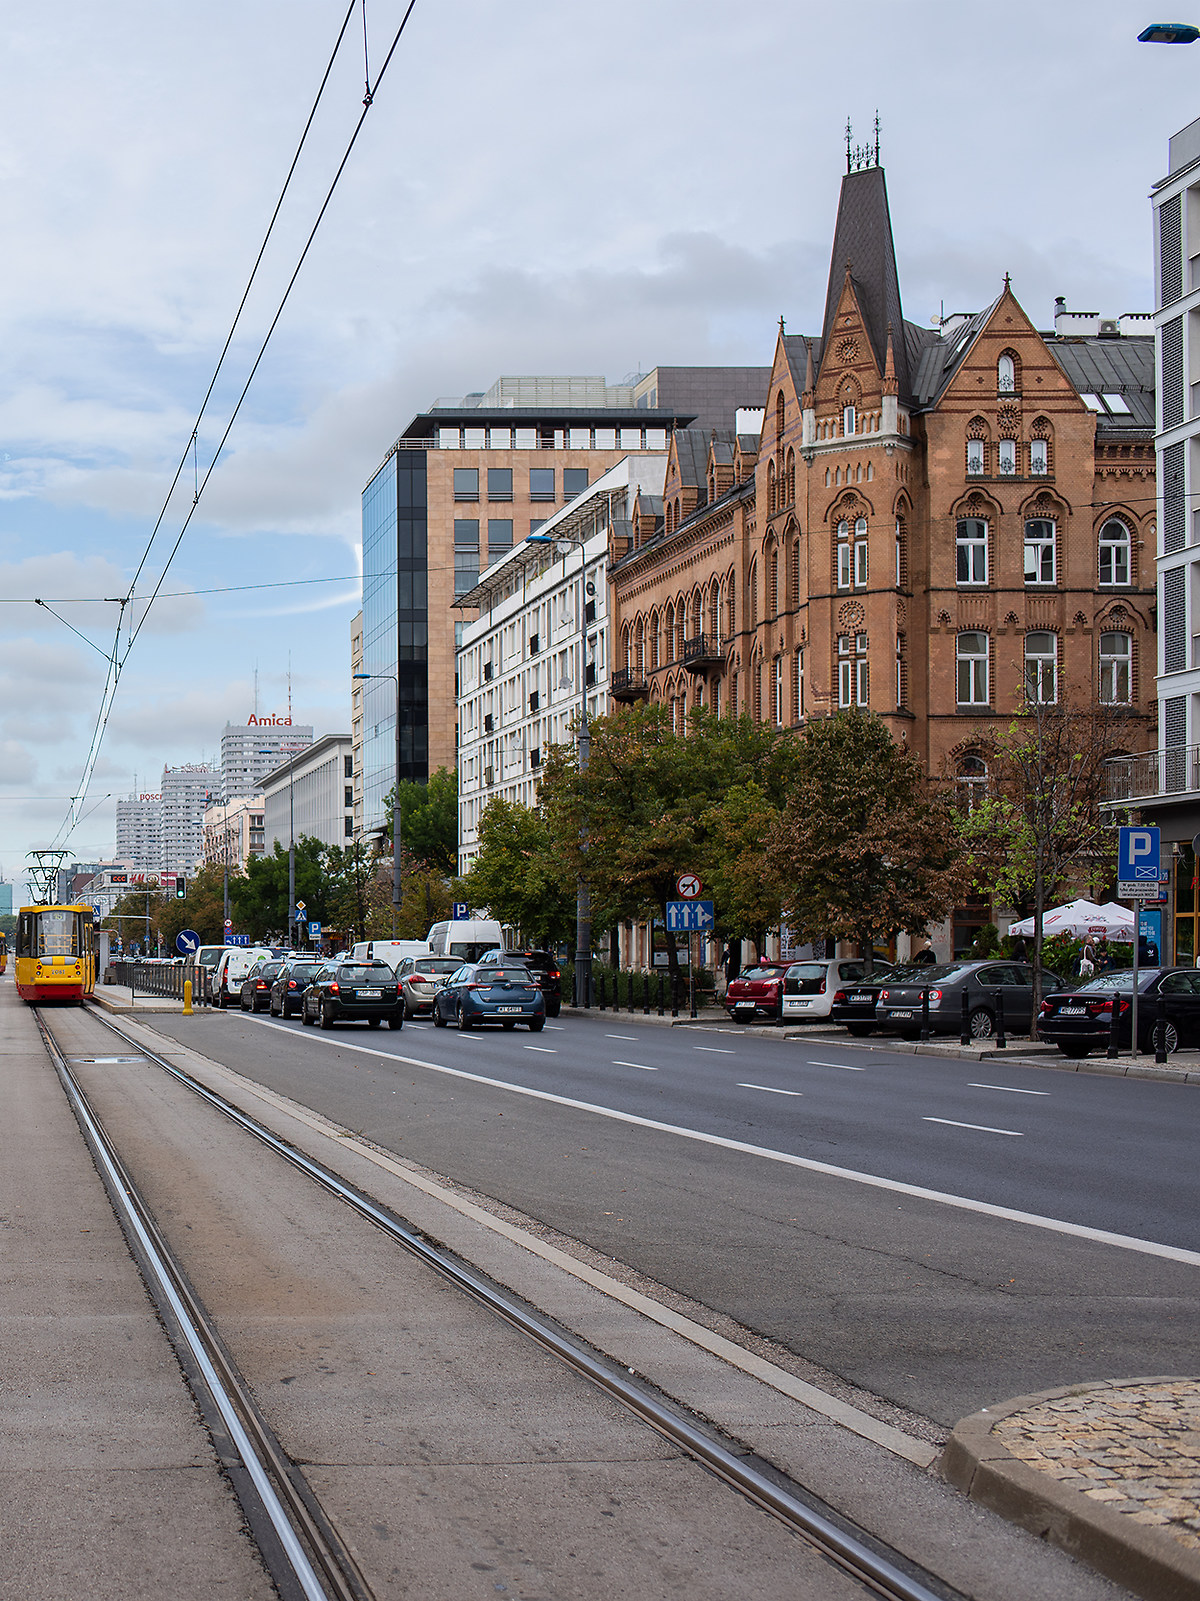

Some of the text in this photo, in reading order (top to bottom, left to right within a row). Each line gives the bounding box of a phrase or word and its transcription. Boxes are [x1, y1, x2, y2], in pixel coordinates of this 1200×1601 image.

[247, 713, 292, 726] Amica
[140, 793, 162, 801] BOSC
[1128, 832, 1152, 865] P
[457, 904, 467, 917] P
[311, 923, 319, 933] P
